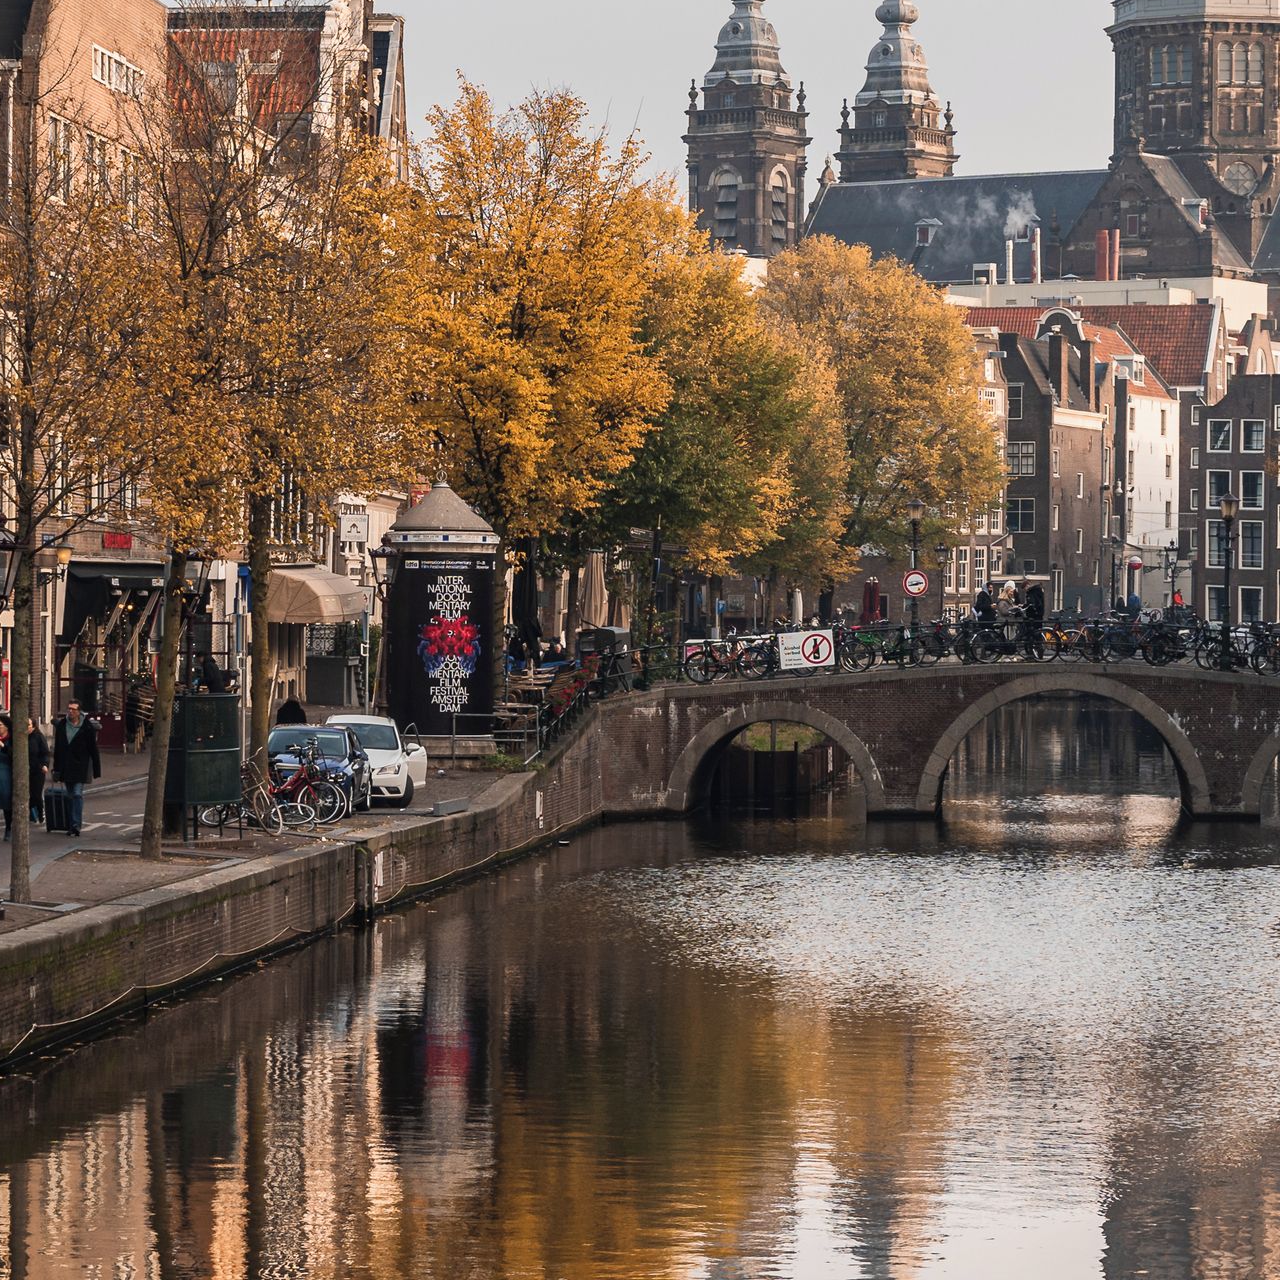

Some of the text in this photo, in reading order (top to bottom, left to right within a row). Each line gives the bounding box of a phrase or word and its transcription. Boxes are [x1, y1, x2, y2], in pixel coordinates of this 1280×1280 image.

[437, 576, 463, 584] INTER
[428, 584, 472, 593] NATIONAL
[436, 593, 465, 601] DOCU
[429, 601, 471, 610] MENTARY
[440, 610, 461, 618] FILM
[429, 670, 470, 678] MENTARY
[440, 678, 461, 686] FILM
[430, 686, 470, 695] FESTIVAL
[431, 695, 467, 704] AMSTER
[439, 703, 461, 712] DAM
